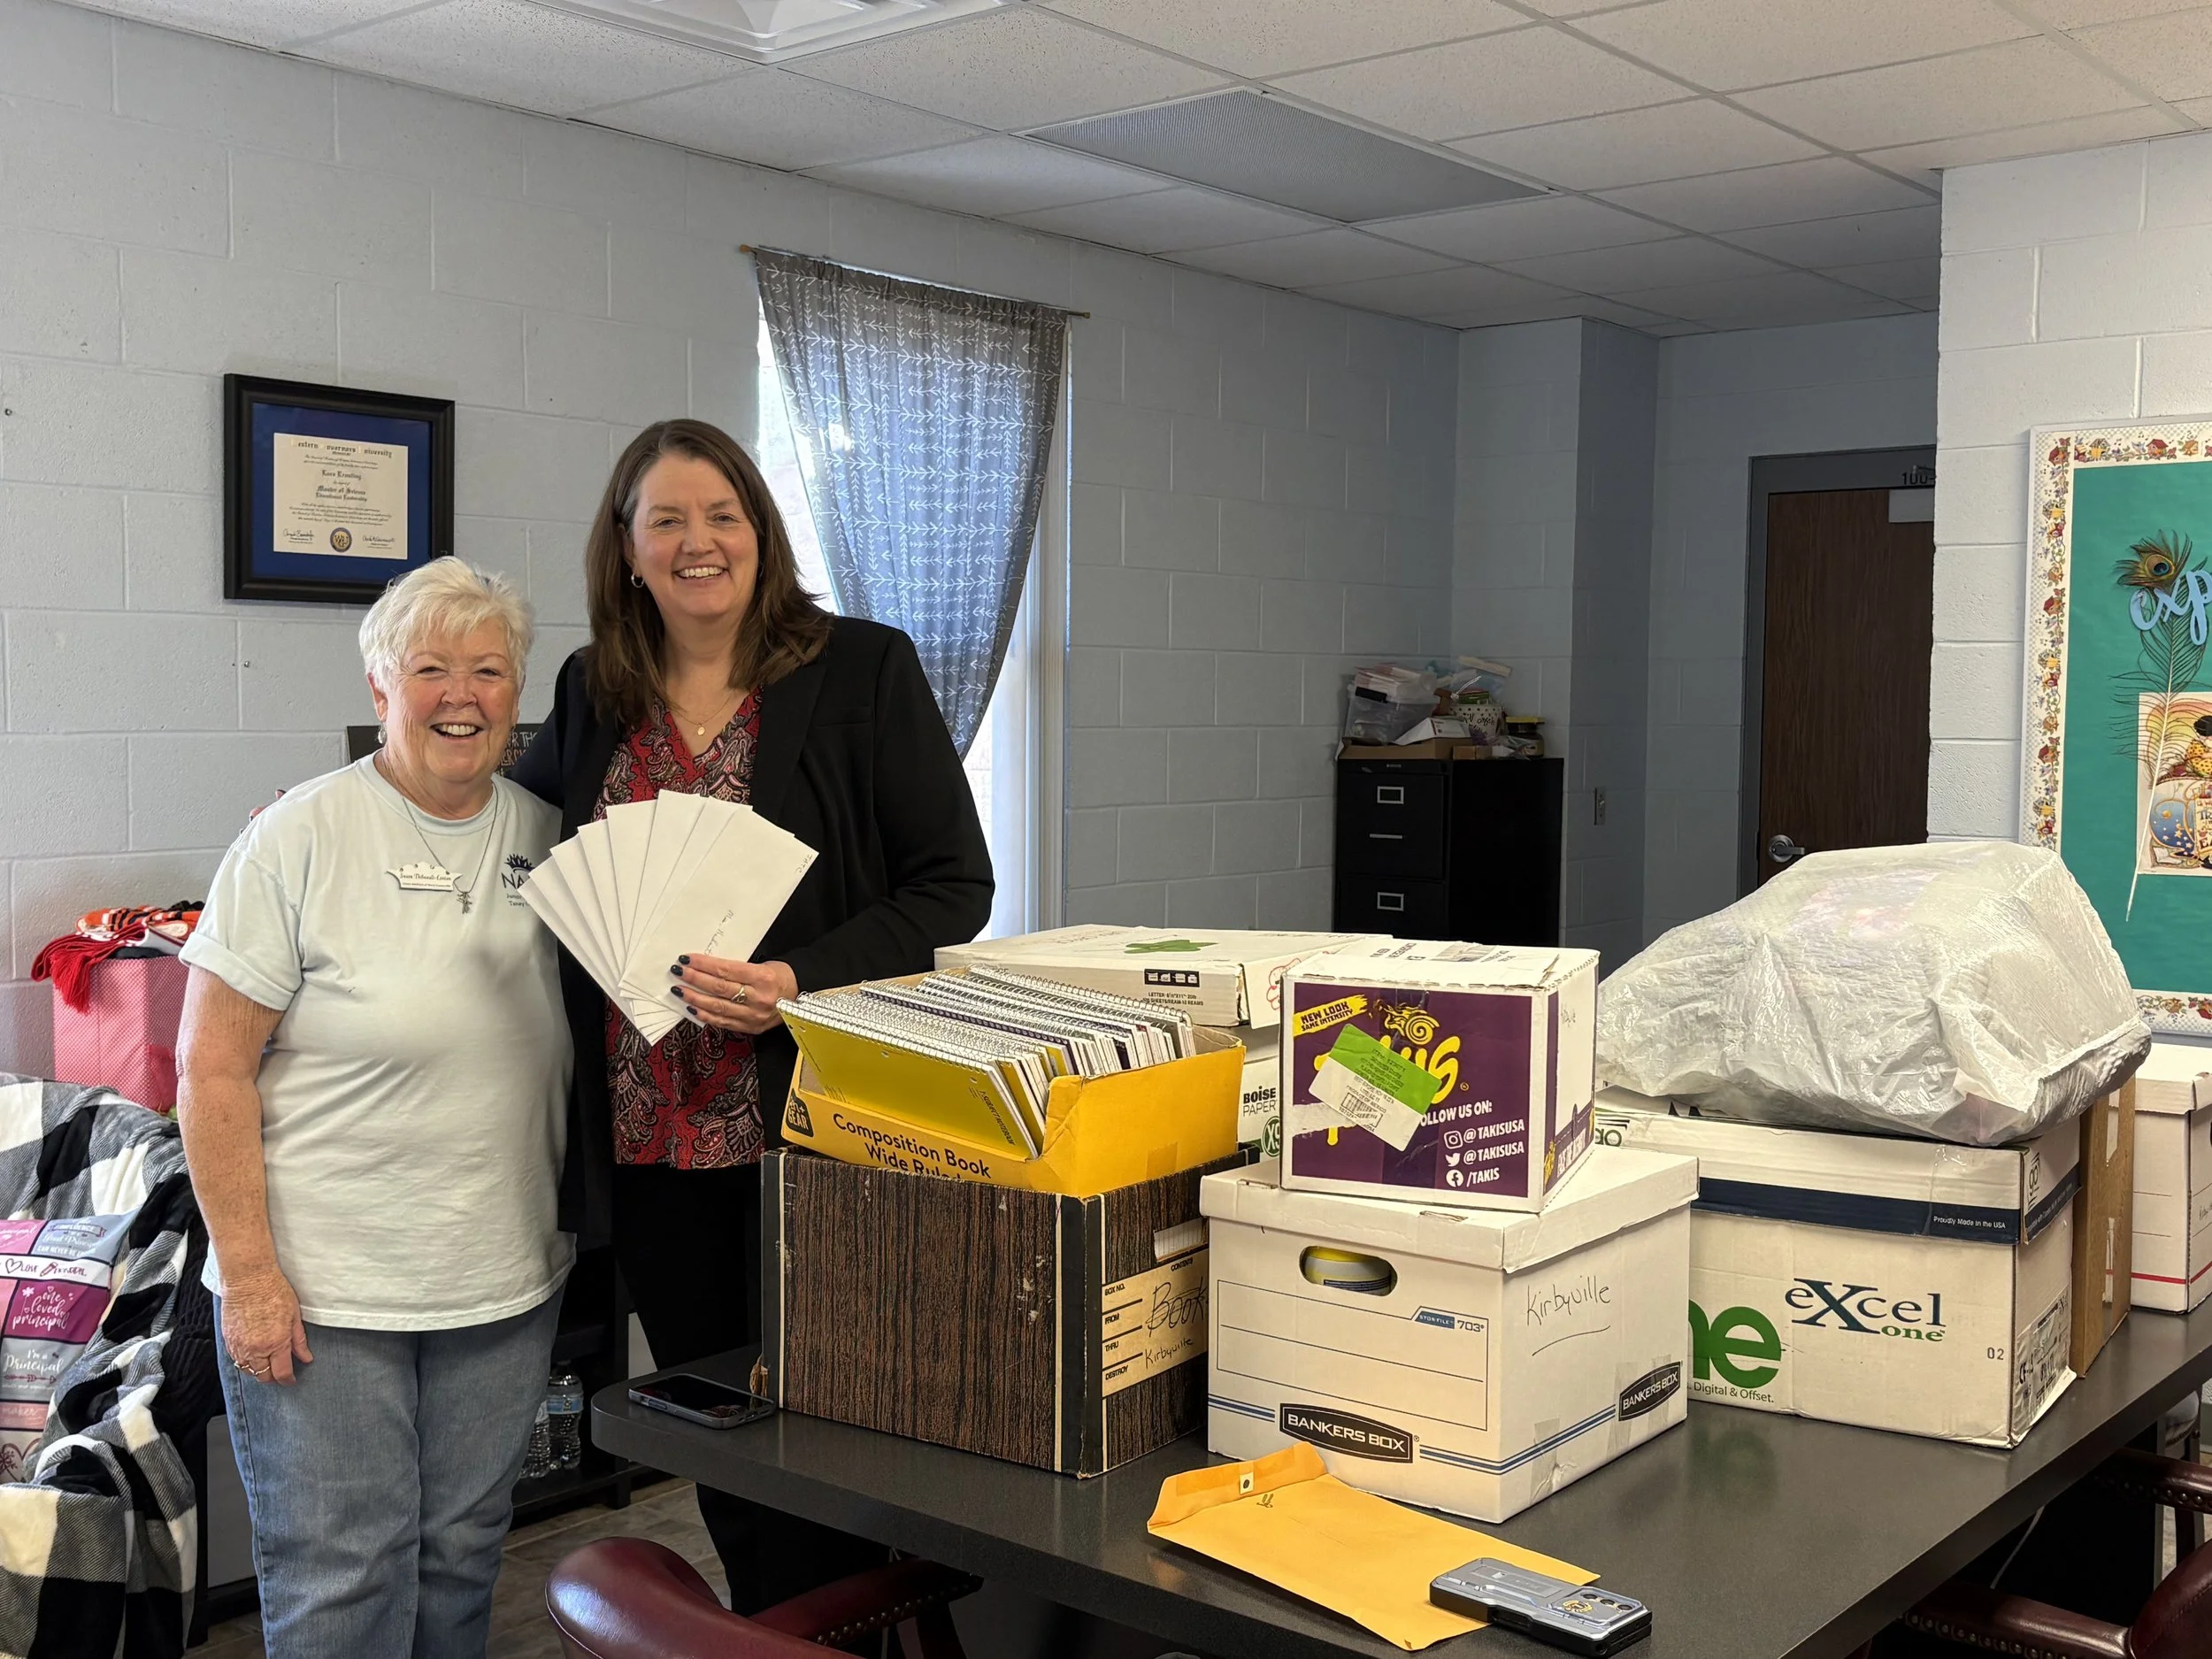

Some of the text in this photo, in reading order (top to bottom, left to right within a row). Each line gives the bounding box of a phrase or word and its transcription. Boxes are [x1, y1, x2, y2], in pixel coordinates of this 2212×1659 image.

[1301, 1001, 1350, 1025] NEW LOOK
[1301, 1008, 1354, 1032] SAME INTENSITY
[1243, 1099, 1276, 1117] PAPER
[1419, 1100, 1493, 1127] OLLOW US ON:
[833, 1112, 992, 1179] Composition Book
[864, 1142, 910, 1171] Wide
[1466, 1167, 1500, 1187] /TAKIS
[1933, 1216, 1956, 1225] Proudly
[31, 1296, 66, 1317] loved
[42, 1292, 61, 1302] one
[1525, 1275, 1611, 1326] Kirbyville
[1785, 1278, 1947, 1334] eXcel
[12, 1312, 70, 1331] principal
[1456, 1319, 1481, 1333] 703
[1881, 1325, 1943, 1342] one
[4, 1353, 64, 1375] Principal
[1986, 1346, 2005, 1361] 02
[1104, 1365, 1129, 1380] DESTROY
[1623, 1371, 1678, 1411] BANKERS BOX
[1694, 1381, 1775, 1403] Digital & Offset.
[1287, 1413, 1406, 1453] BANKERS BOX
